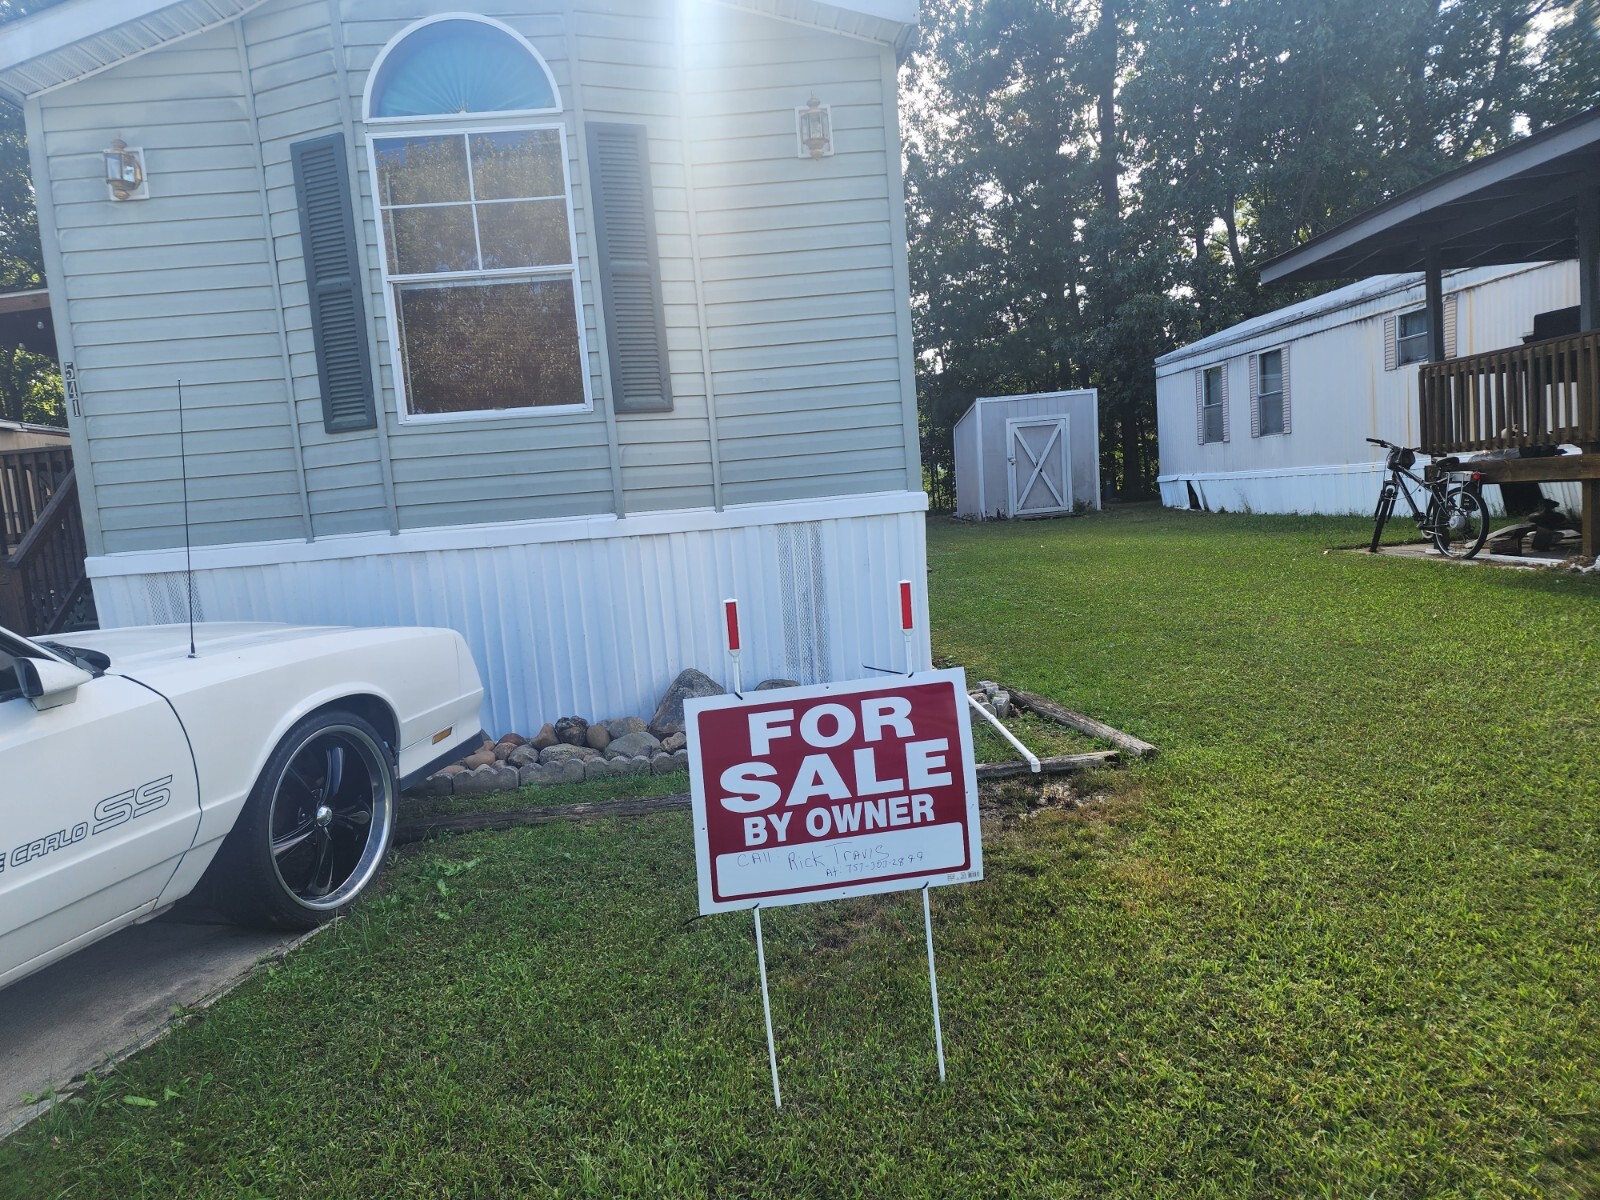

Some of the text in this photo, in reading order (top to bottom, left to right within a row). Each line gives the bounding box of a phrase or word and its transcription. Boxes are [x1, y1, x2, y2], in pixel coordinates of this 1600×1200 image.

[64, 361, 81, 417] 541
[748, 697, 915, 756] FOR
[720, 738, 952, 813] SALE
[10, 774, 173, 867] CARLO SS
[743, 793, 935, 846] BY OWNER
